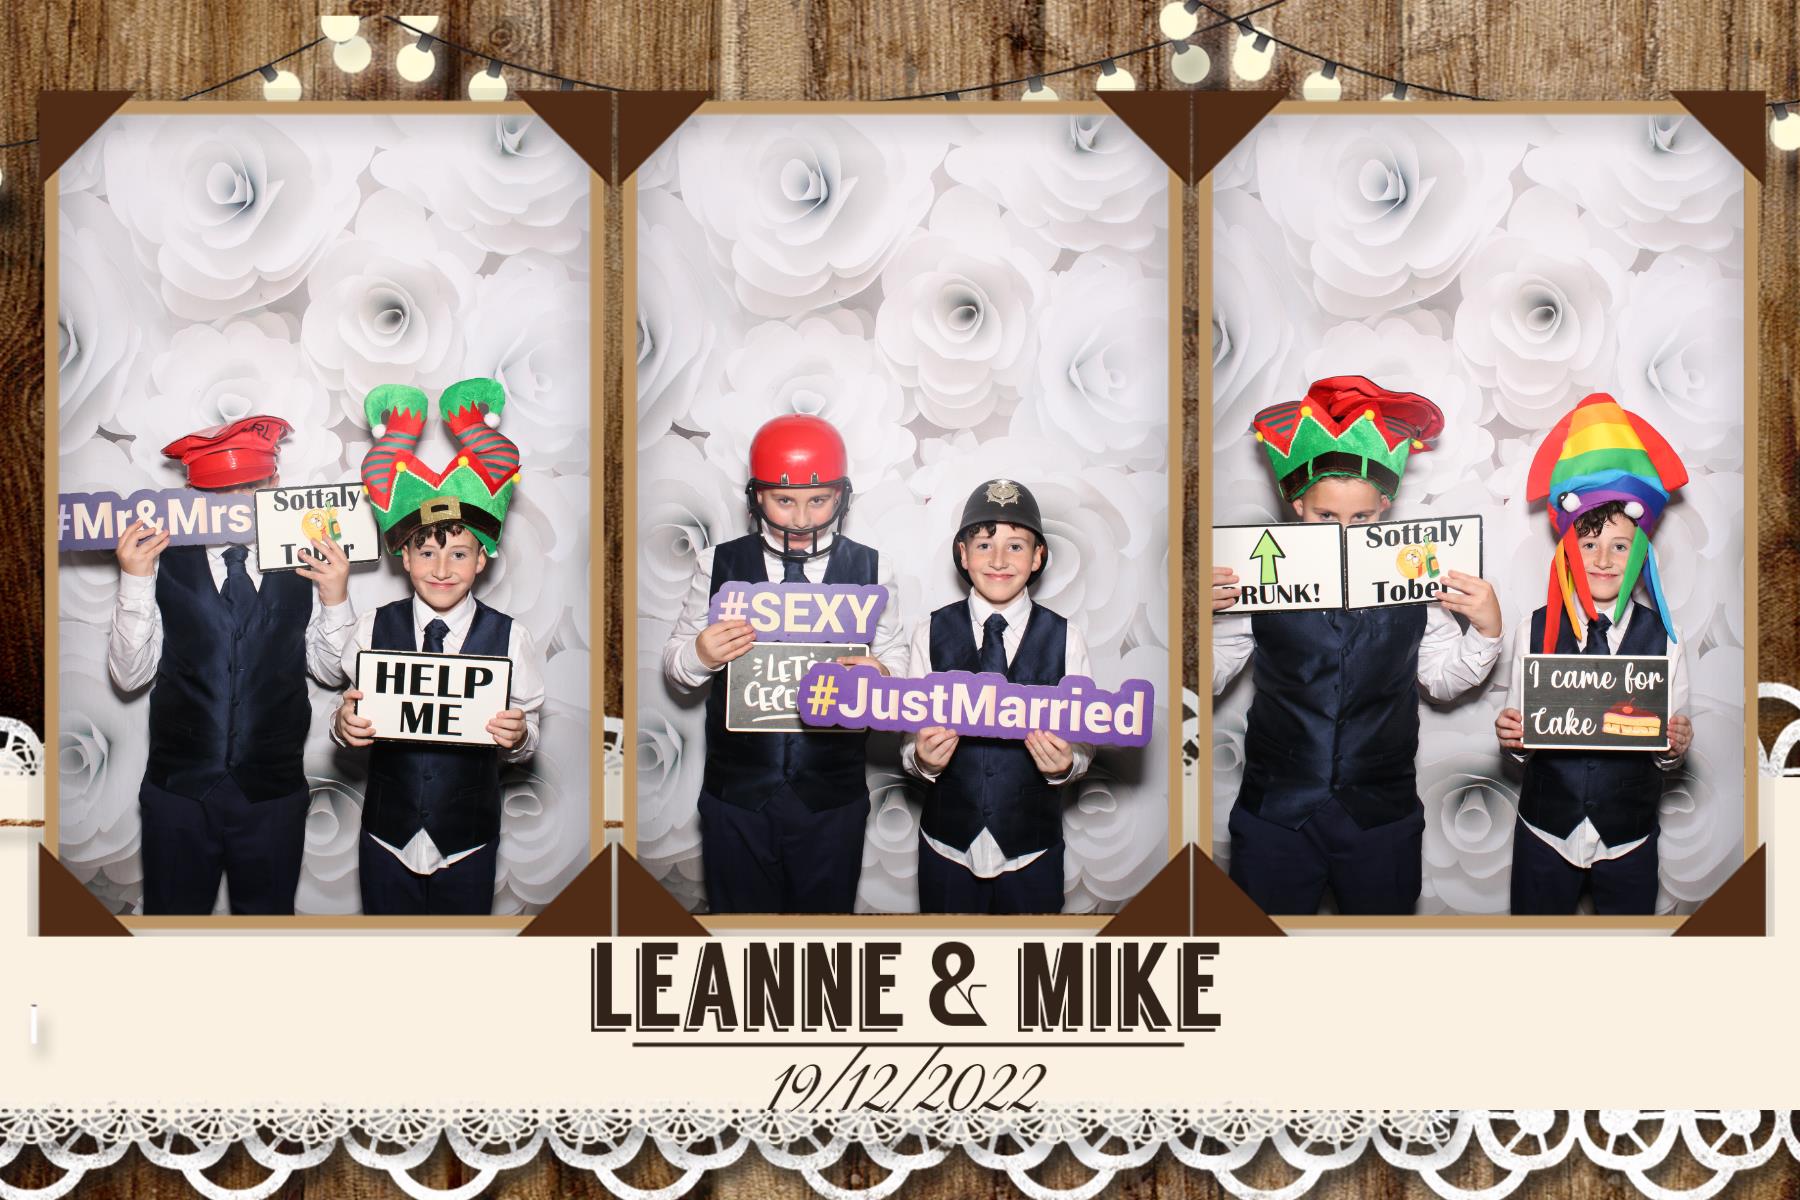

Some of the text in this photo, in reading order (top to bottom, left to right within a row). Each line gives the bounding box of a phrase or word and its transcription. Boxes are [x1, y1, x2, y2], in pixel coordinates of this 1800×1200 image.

[273, 485, 360, 512] Sottaly
[1366, 520, 1463, 548] Sottaly
[1221, 583, 1320, 606] RUNK!
[718, 591, 879, 634] #SEXY
[376, 661, 493, 699] HELP
[1529, 660, 1664, 694] I came for
[400, 701, 462, 736] ME
[807, 674, 1145, 736] #JustMarried
[1530, 707, 1597, 736] Cake
